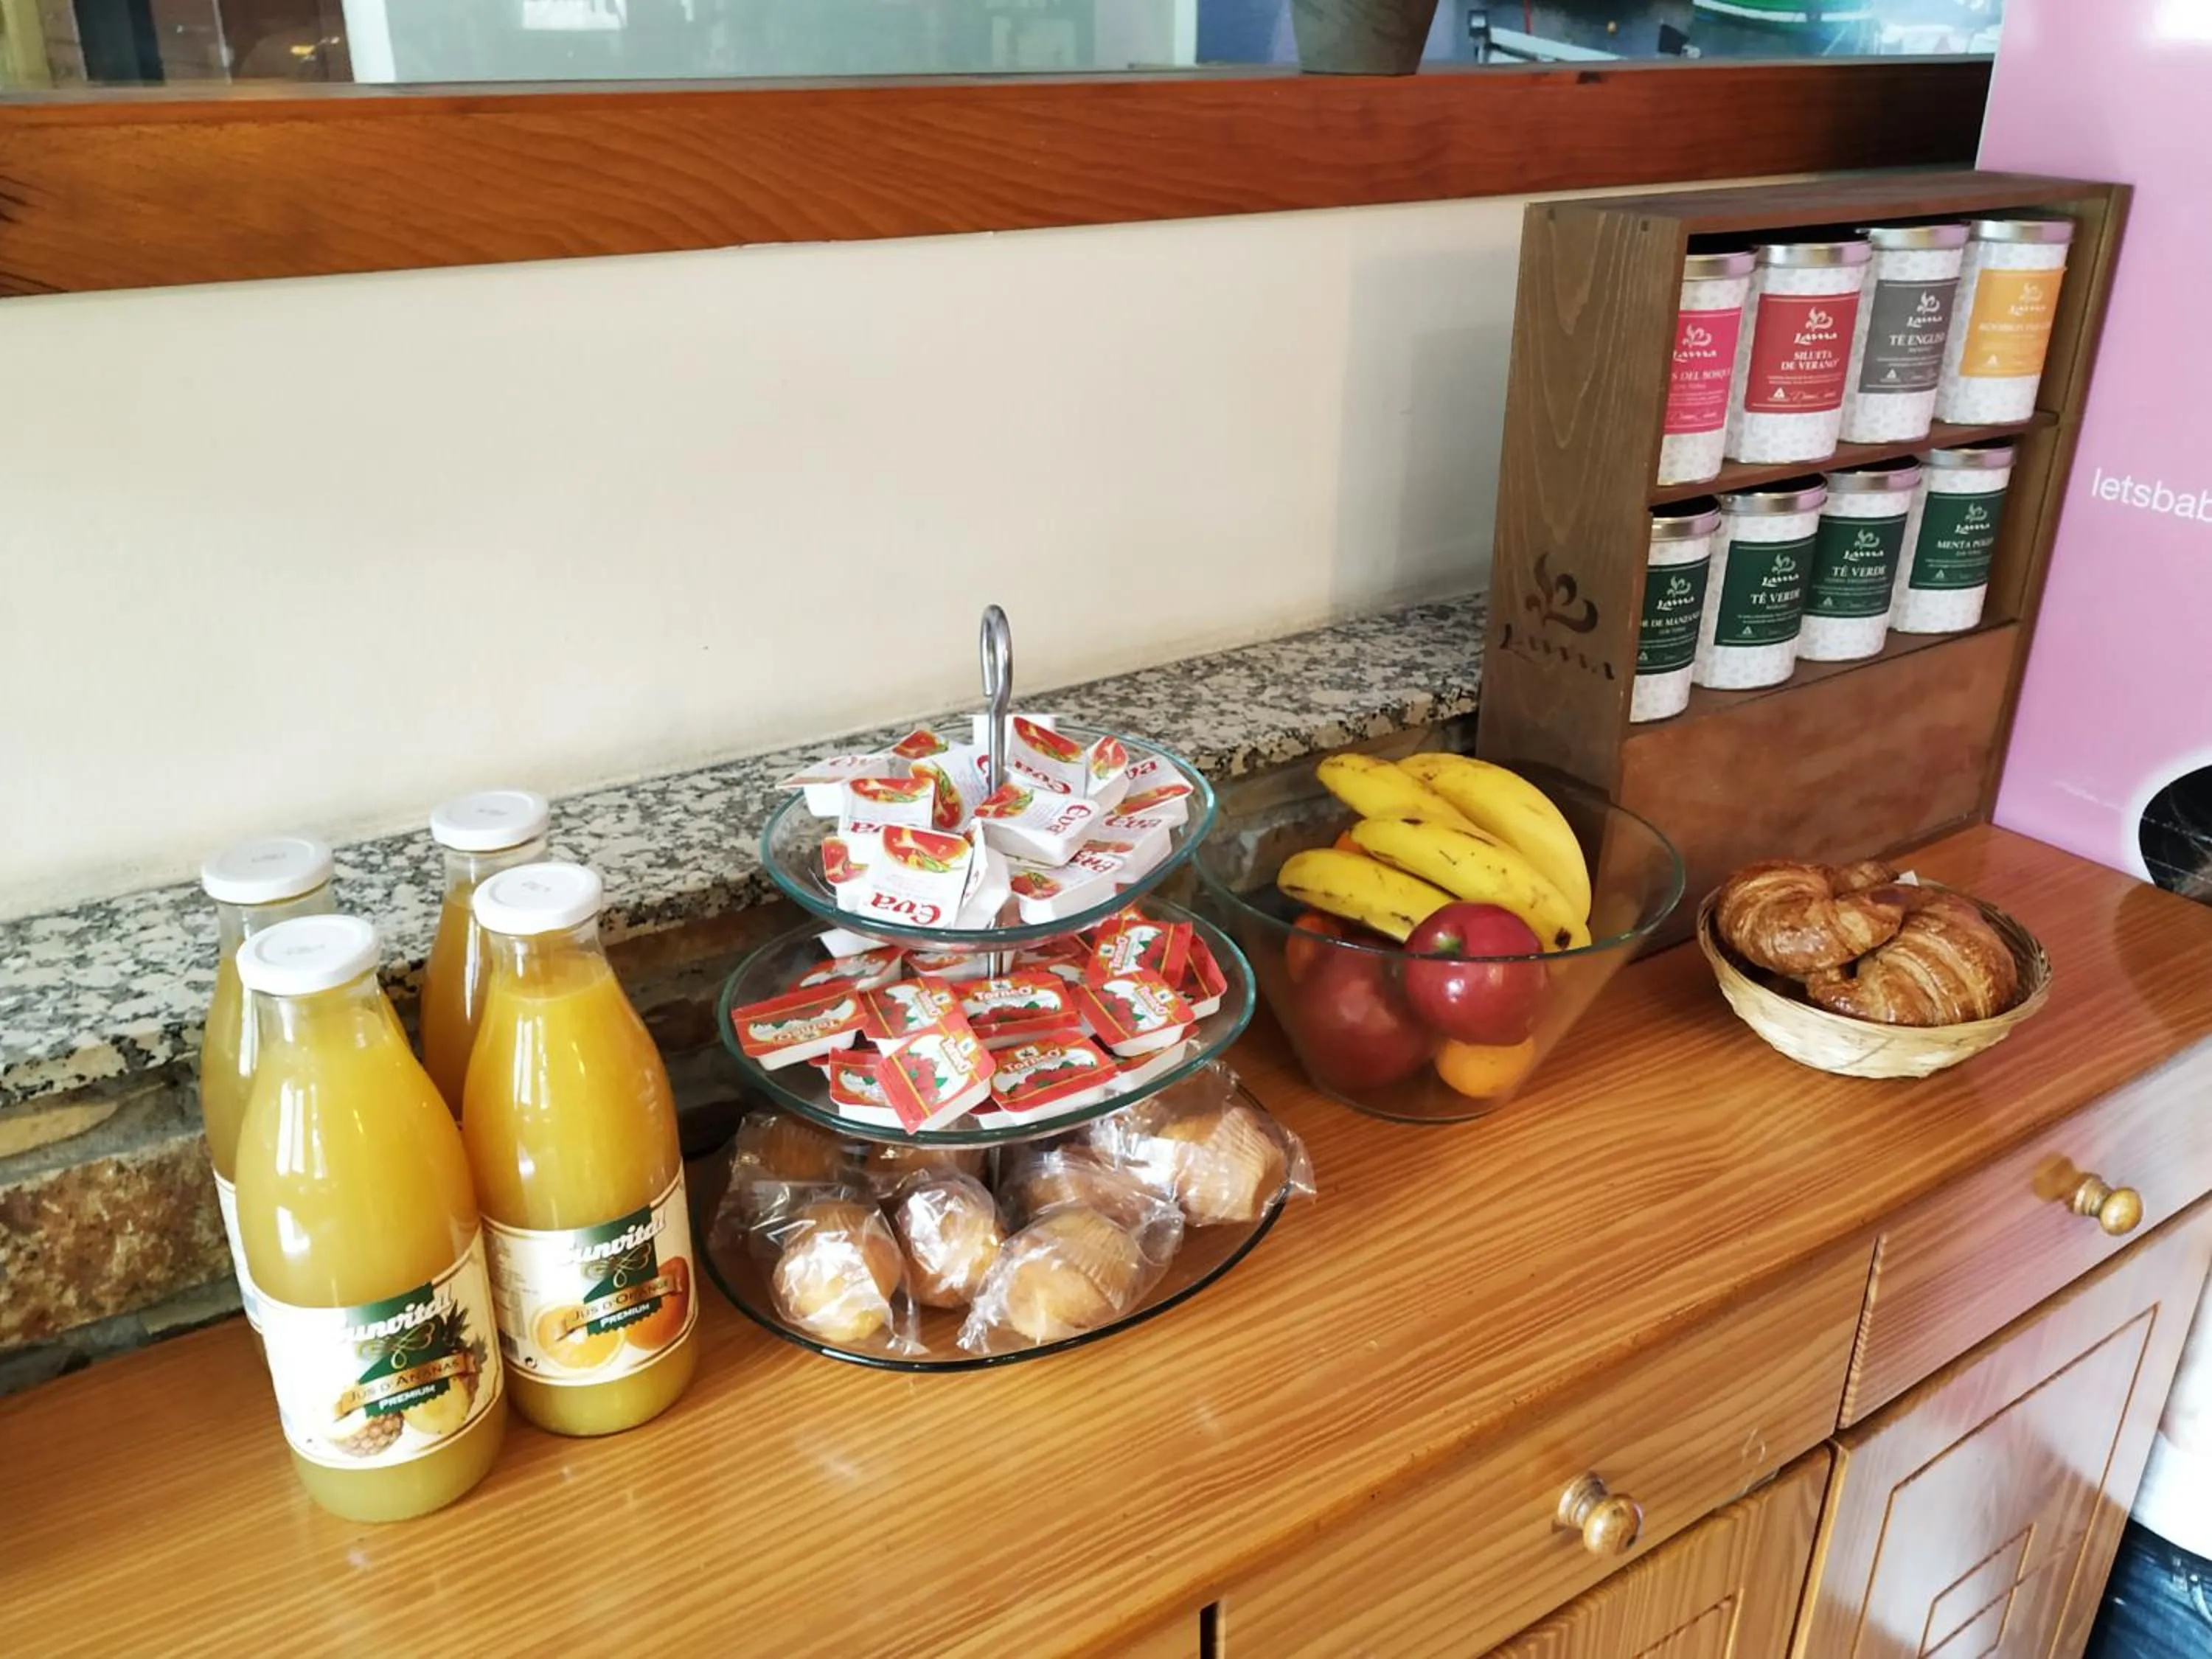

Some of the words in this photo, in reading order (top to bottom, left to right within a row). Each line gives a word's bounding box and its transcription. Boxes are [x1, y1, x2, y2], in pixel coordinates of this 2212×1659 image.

[1781, 361, 1796, 370] DE
[1936, 540, 1971, 549] MENTA
[1851, 566, 1887, 577] VERDE
[1125, 760, 1158, 780] va
[870, 891, 942, 925] Eva
[568, 1207, 667, 1262] unvital
[599, 1301, 650, 1328] PREMIUM
[378, 1383, 437, 1410] PREMIUM
